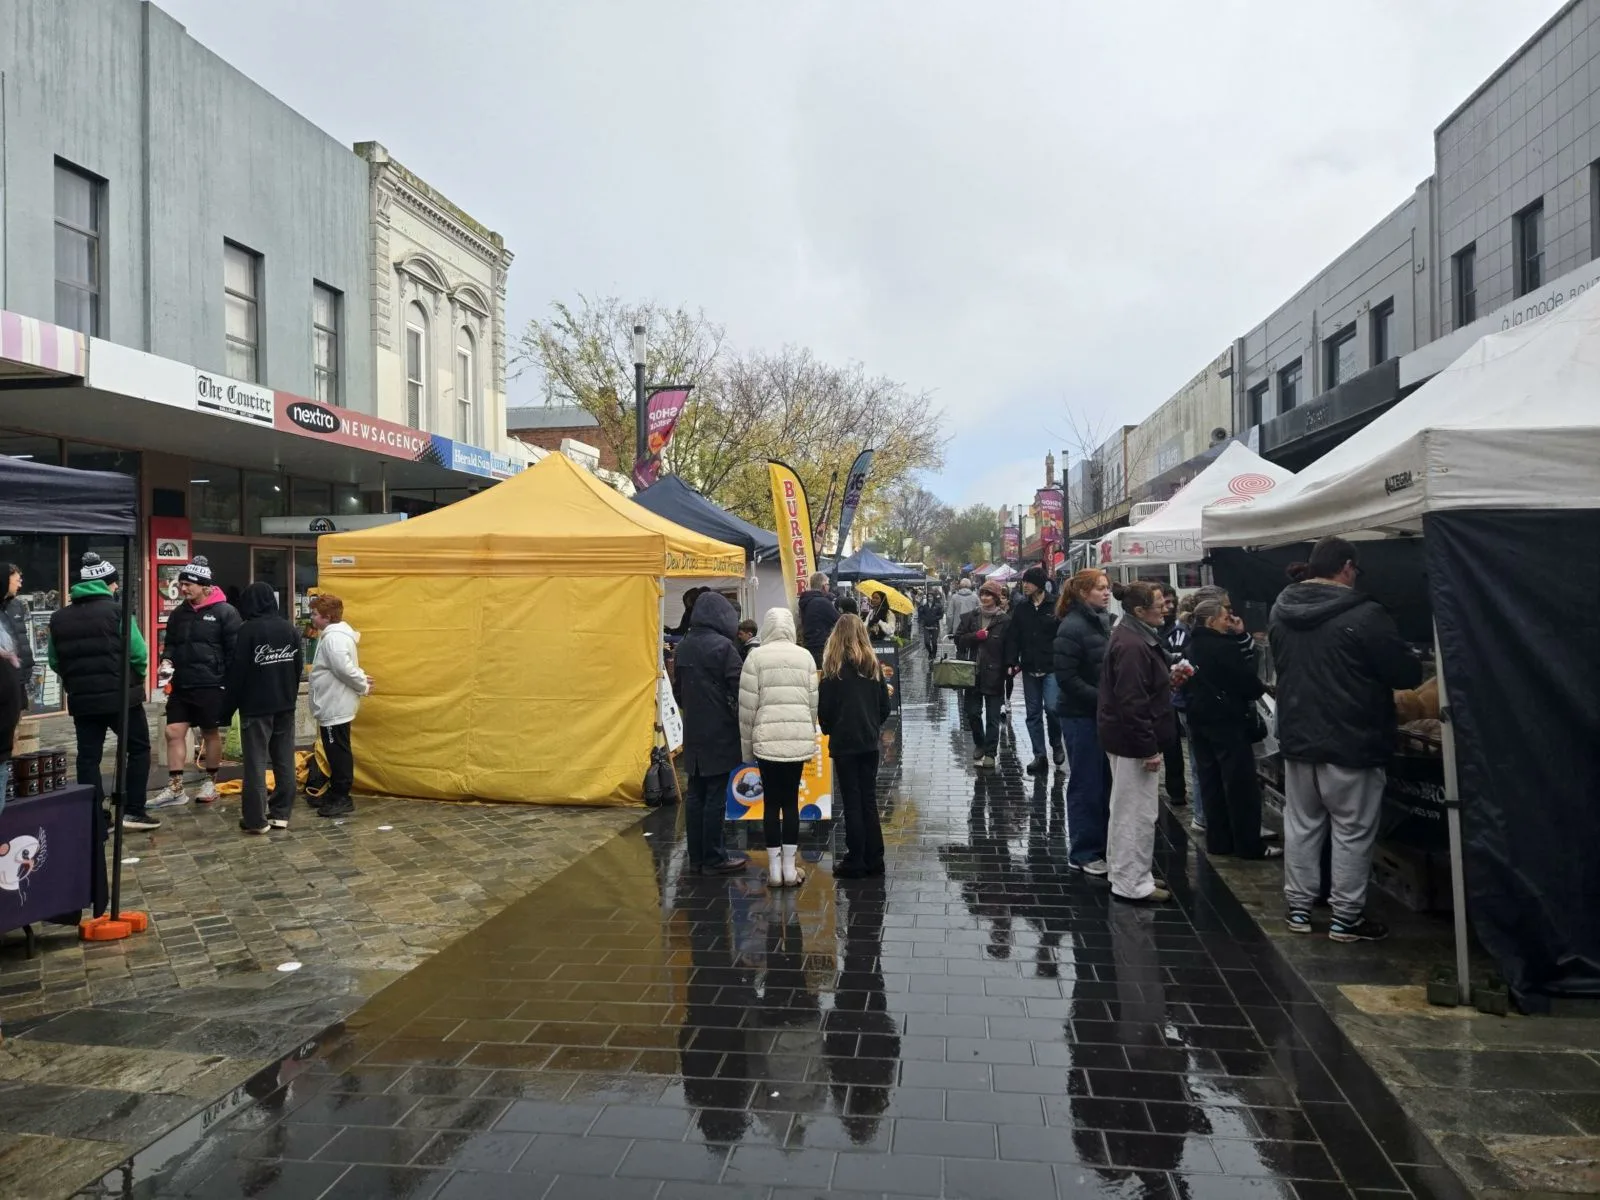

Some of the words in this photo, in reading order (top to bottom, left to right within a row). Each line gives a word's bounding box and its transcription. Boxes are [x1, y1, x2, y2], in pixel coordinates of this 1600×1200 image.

[1513, 309, 1523, 327] la
[1527, 291, 1564, 321] mode
[198, 374, 222, 399] The
[227, 385, 271, 413] Courier
[293, 406, 334, 428] nextra
[341, 419, 425, 453] NEWSAGENCY
[455, 448, 477, 467] Herald
[478, 455, 490, 470] Sun
[1146, 531, 1201, 560] peerick
[168, 579, 180, 600] 6
